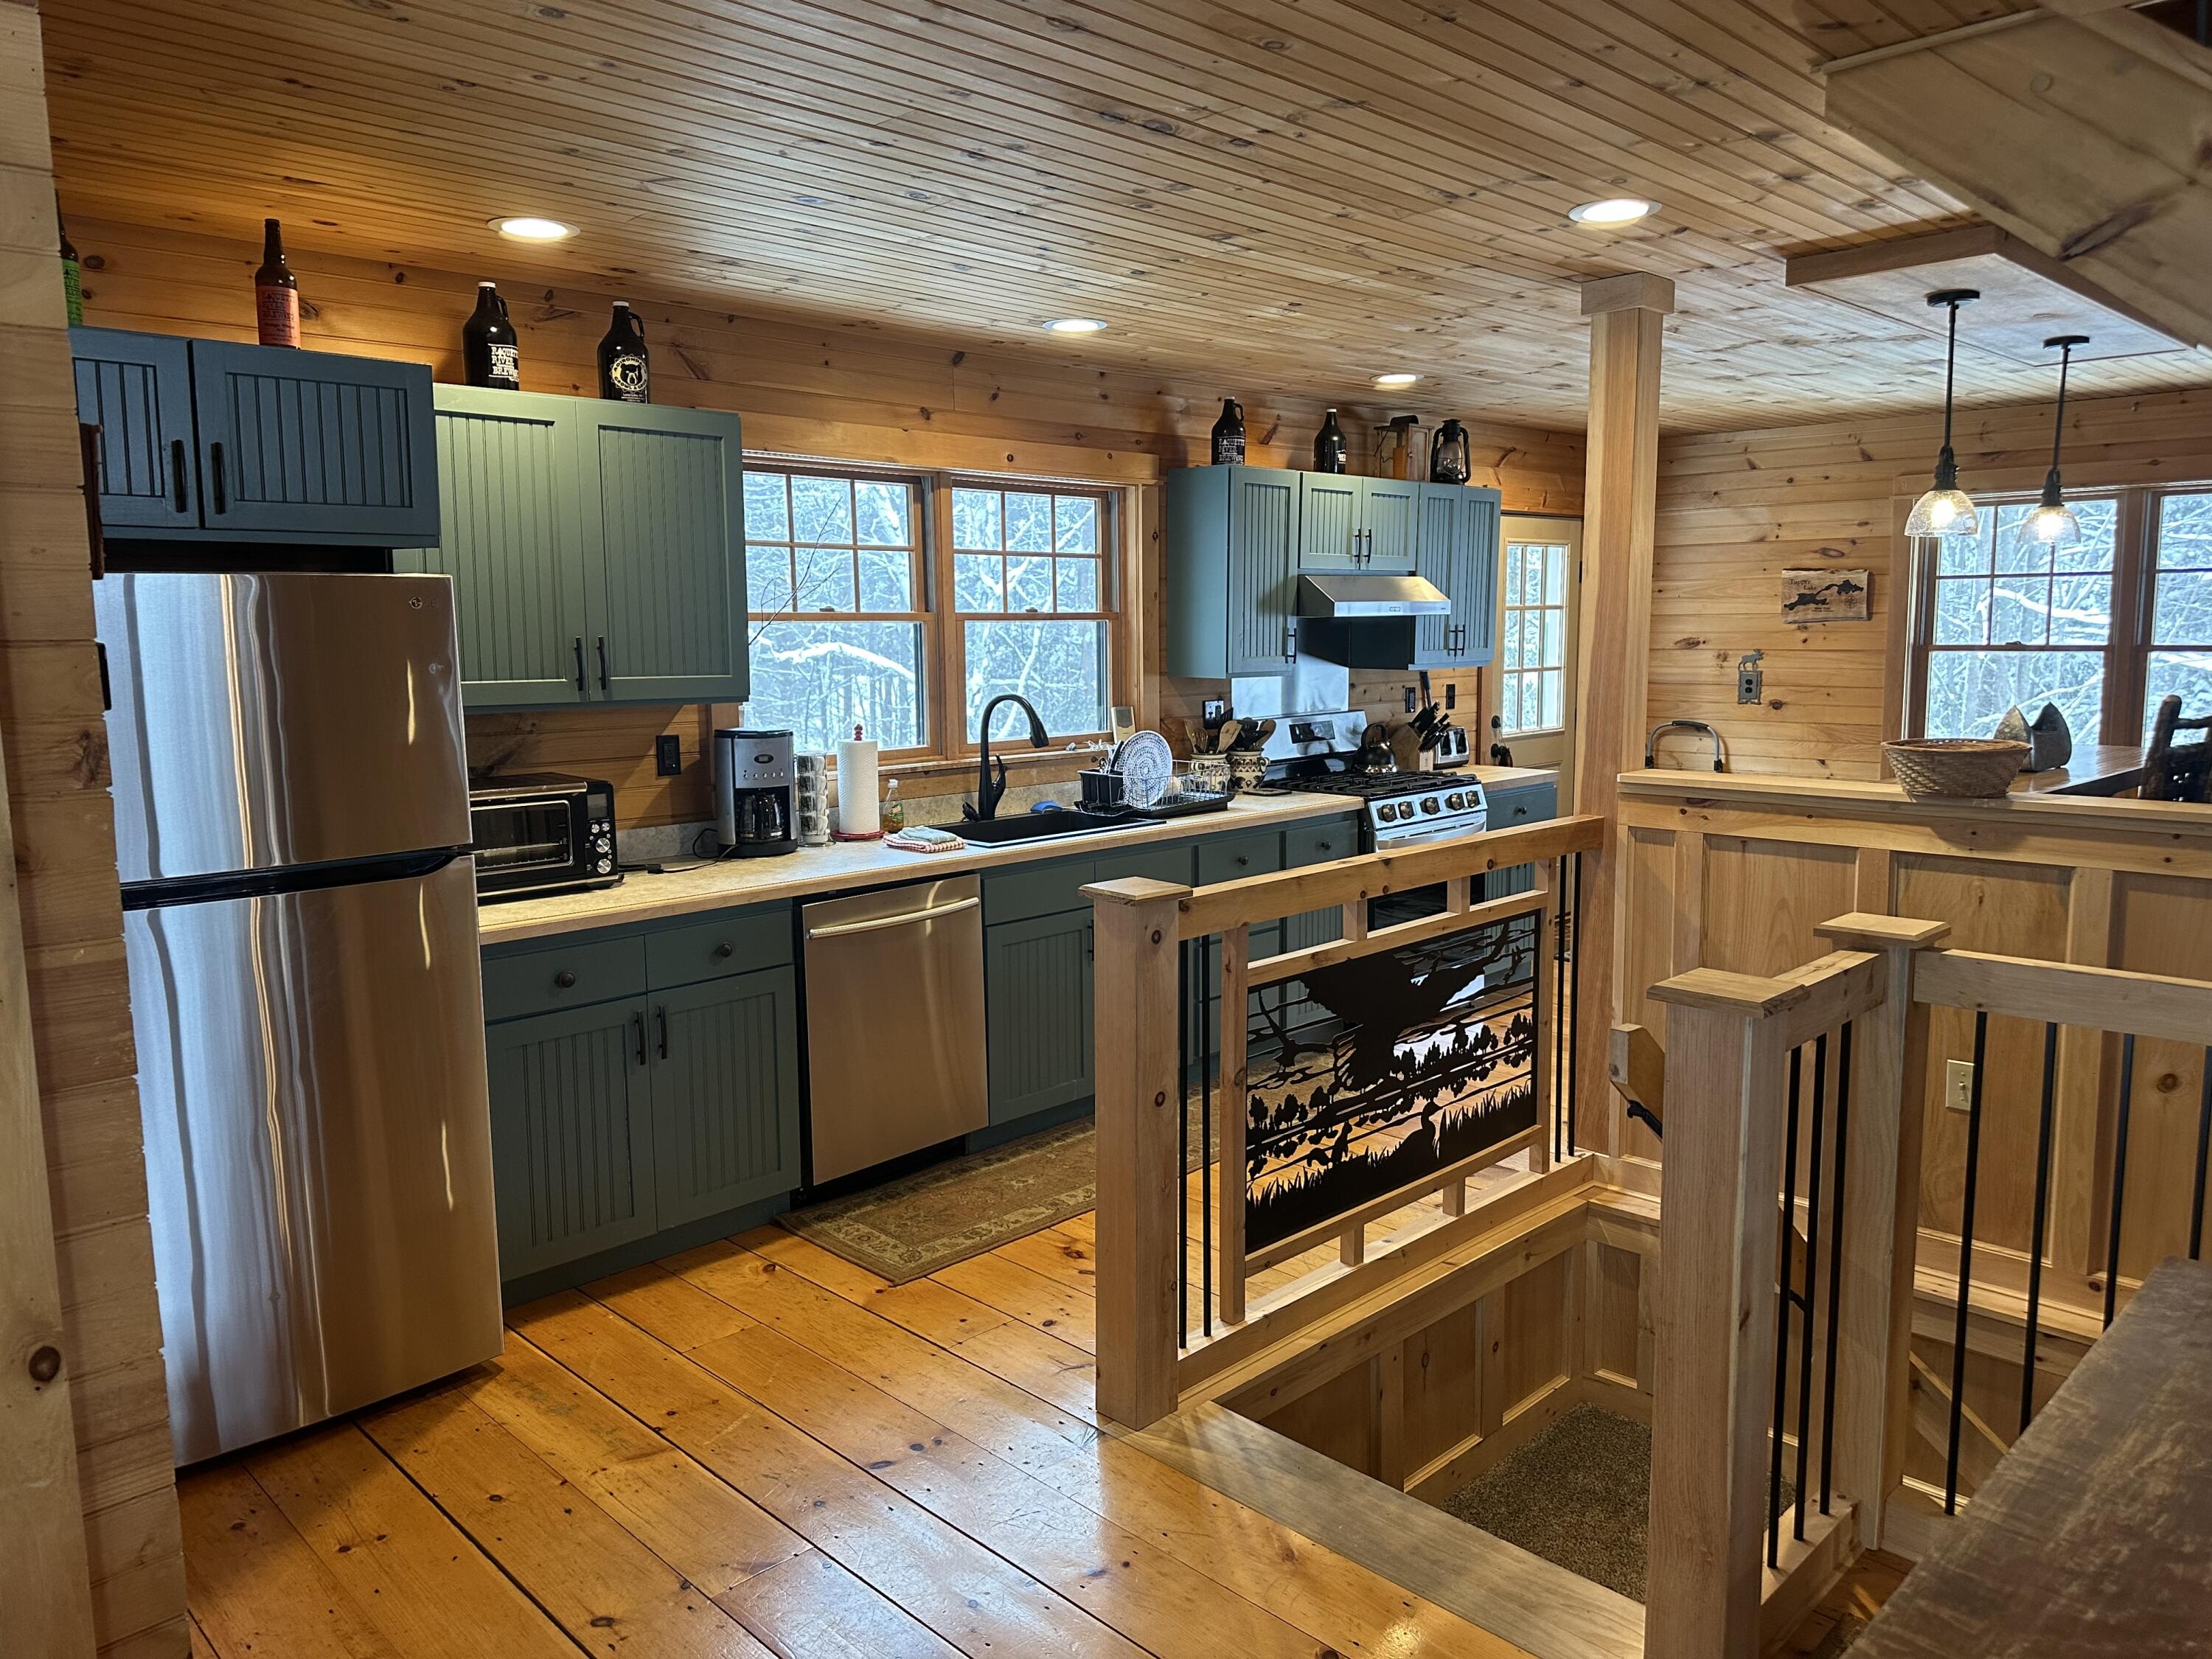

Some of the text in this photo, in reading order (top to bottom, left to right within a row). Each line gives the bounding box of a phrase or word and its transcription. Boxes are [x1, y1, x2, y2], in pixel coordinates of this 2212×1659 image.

[491, 355, 514, 366] RIVER
[1218, 445, 1238, 453] RIVER
[1789, 578, 1811, 586] Tupper
